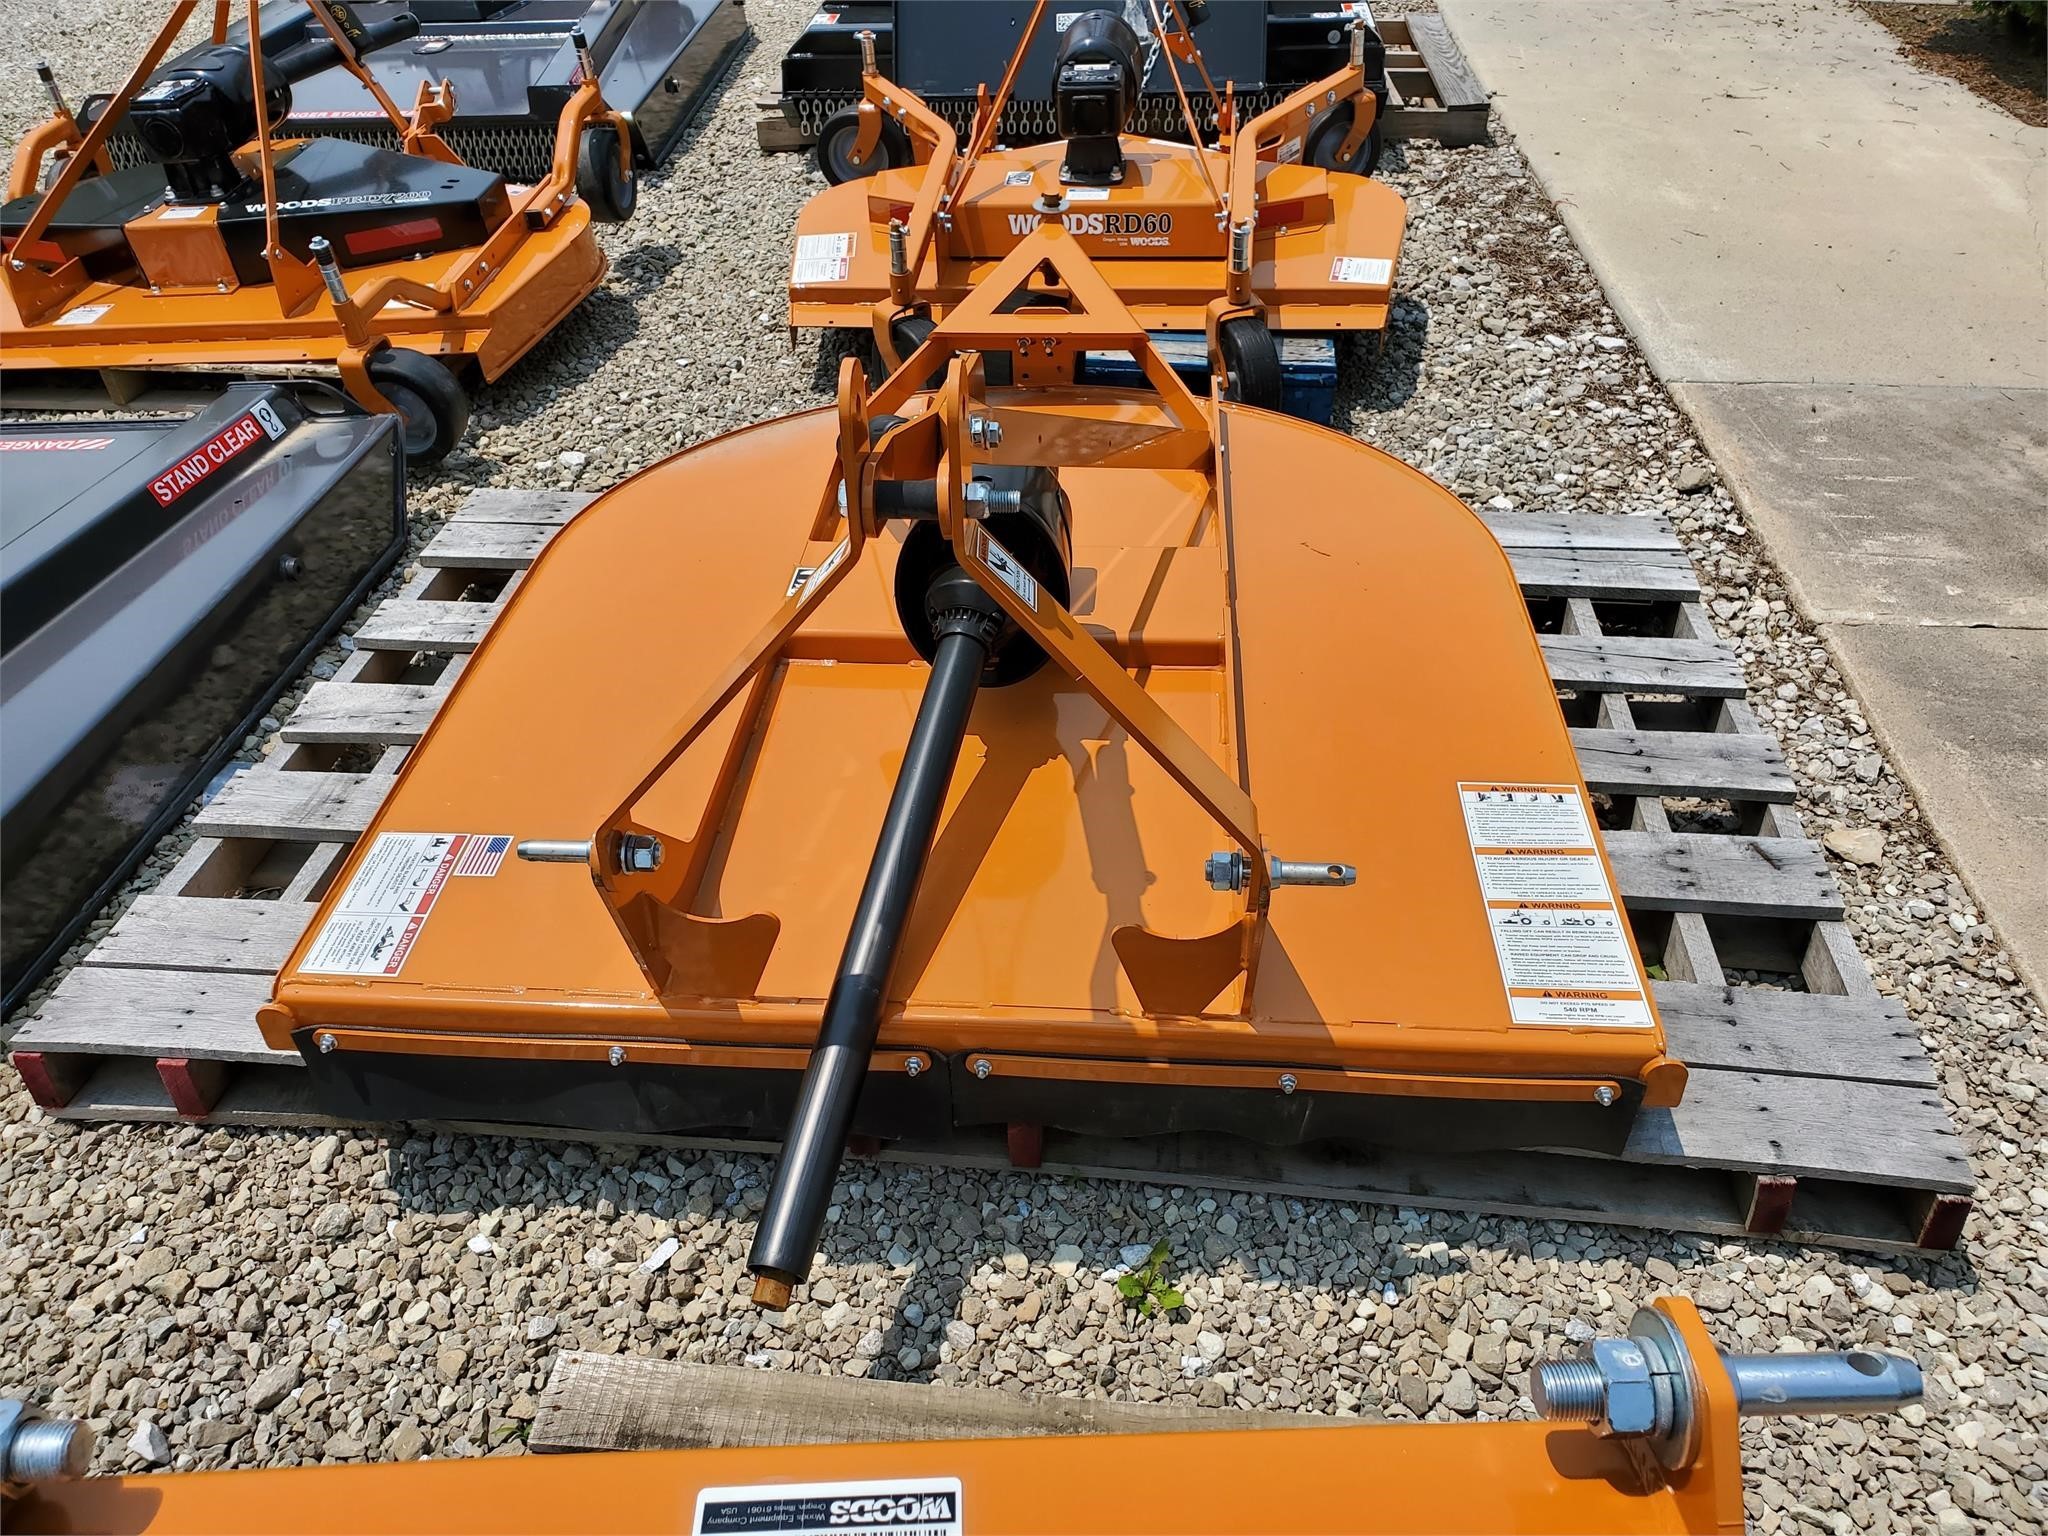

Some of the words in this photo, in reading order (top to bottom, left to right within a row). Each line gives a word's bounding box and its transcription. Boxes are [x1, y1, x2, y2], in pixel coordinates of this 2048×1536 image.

[0, 440, 76, 450] DANGE
[153, 454, 210, 501] STAND
[207, 419, 259, 463] CLEAR
[426, 863, 450, 895] DANGER
[388, 933, 412, 968] DANGER
[1555, 991, 1608, 999] WARNING
[747, 1505, 772, 1513] 61061
[828, 1496, 953, 1524] WOODS
[706, 1516, 748, 1525] Company
[749, 1513, 794, 1524] Equipment
[796, 1513, 826, 1521] Woods
